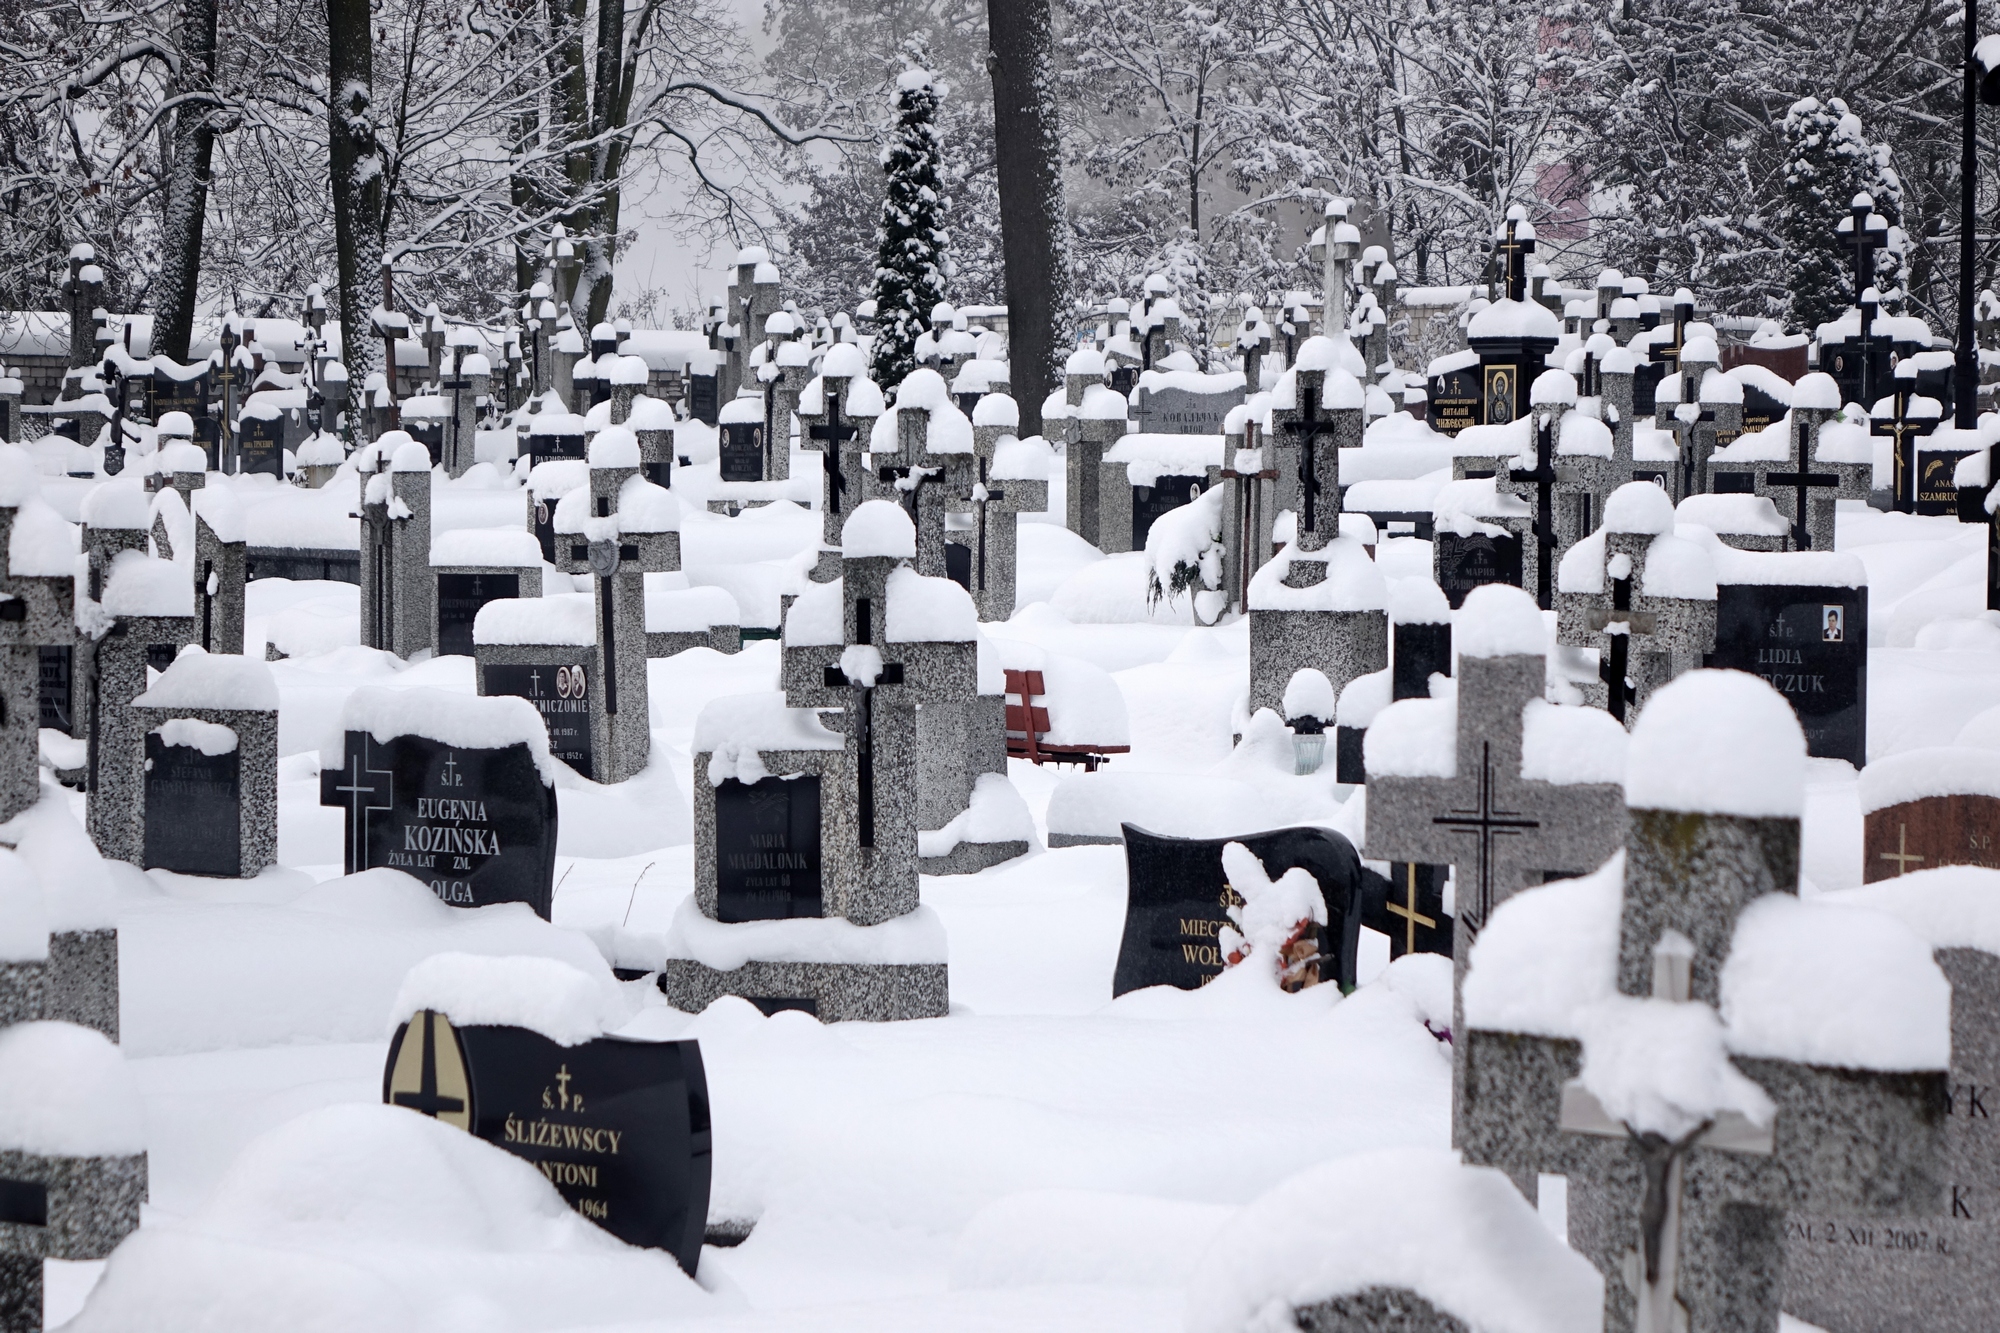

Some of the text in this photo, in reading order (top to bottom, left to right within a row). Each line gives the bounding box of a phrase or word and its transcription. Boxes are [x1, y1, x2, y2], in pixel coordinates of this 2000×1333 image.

[1442, 405, 1469, 416] ВИТАЛИЙ
[1465, 567, 1496, 577] МАРИЯ
[1769, 624, 1793, 638] Ś. P.
[1758, 648, 1803, 665] LIDIA
[530, 699, 588, 713] ENICZONIE
[441, 769, 464, 787] Ś. P.
[416, 797, 488, 822] EUGENIA
[403, 819, 501, 856] KOZIŃSKA
[749, 833, 785, 849] MARIA
[388, 849, 471, 870] ŻYŁA LAT ZM.
[727, 852, 808, 870] MAGDALONIK
[542, 1085, 585, 1114] Ś. P.
[504, 1111, 623, 1155] ŚLIŻEWSCY
[578, 1197, 609, 1220] 1964
[1825, 1225, 1837, 1243] 2
